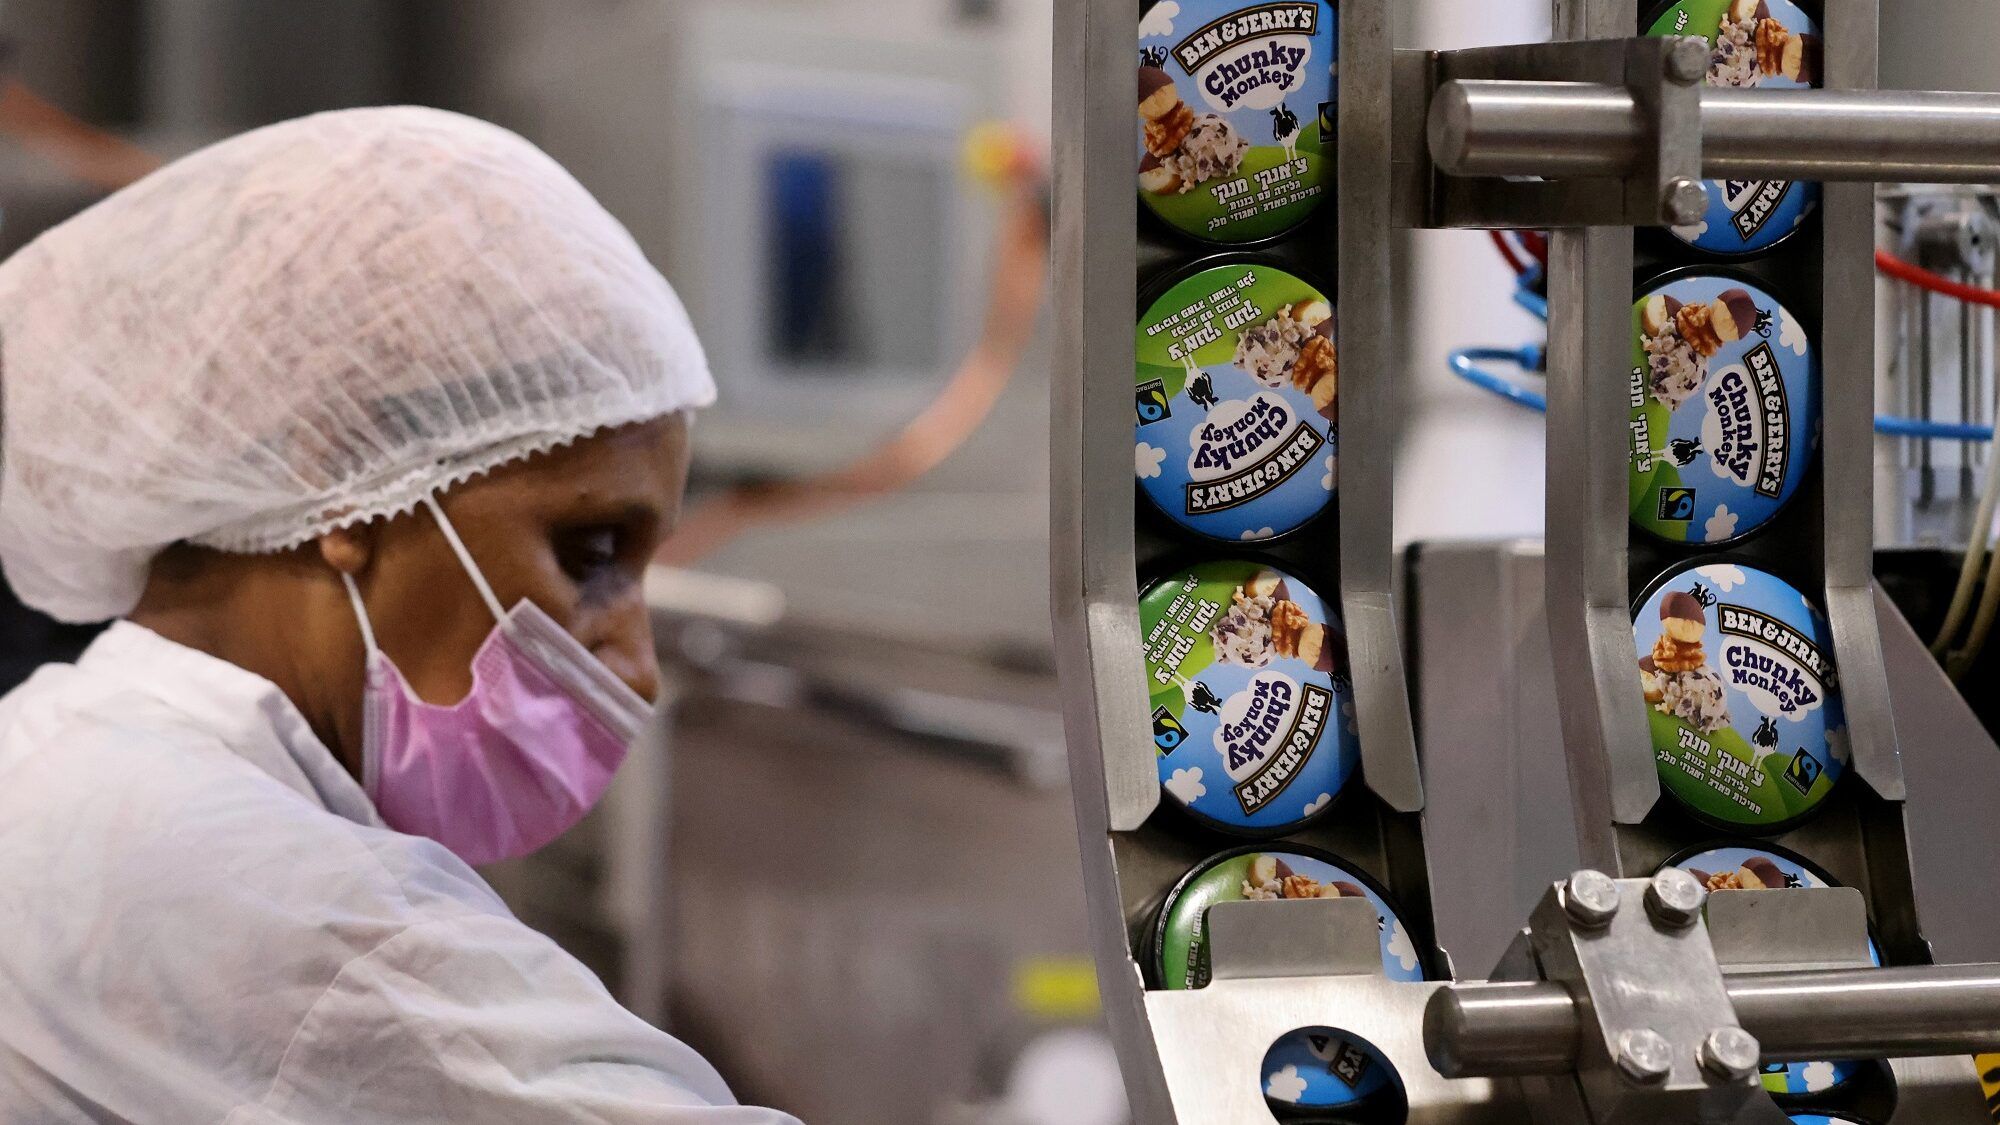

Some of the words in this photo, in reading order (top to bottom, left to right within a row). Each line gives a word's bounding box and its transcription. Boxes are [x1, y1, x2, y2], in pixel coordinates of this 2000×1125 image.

[1205, 41, 1305, 96] Chunky
[1220, 69, 1295, 108] Monkey
[1210, 178, 1249, 205] מנקי
[1223, 299, 1262, 330] מנקי
[1193, 406, 1288, 471] Chunky
[1201, 396, 1271, 442] Monkey
[1709, 386, 1737, 466] Monkey
[1721, 372, 1758, 480] Chunky
[1188, 597, 1220, 634] מנקי
[1726, 645, 1817, 705] Chunky
[1732, 669, 1797, 712] Monkey
[1223, 679, 1270, 743] Monkey
[1228, 680, 1292, 771] Chunky
[1677, 726, 1711, 757] מנקי
